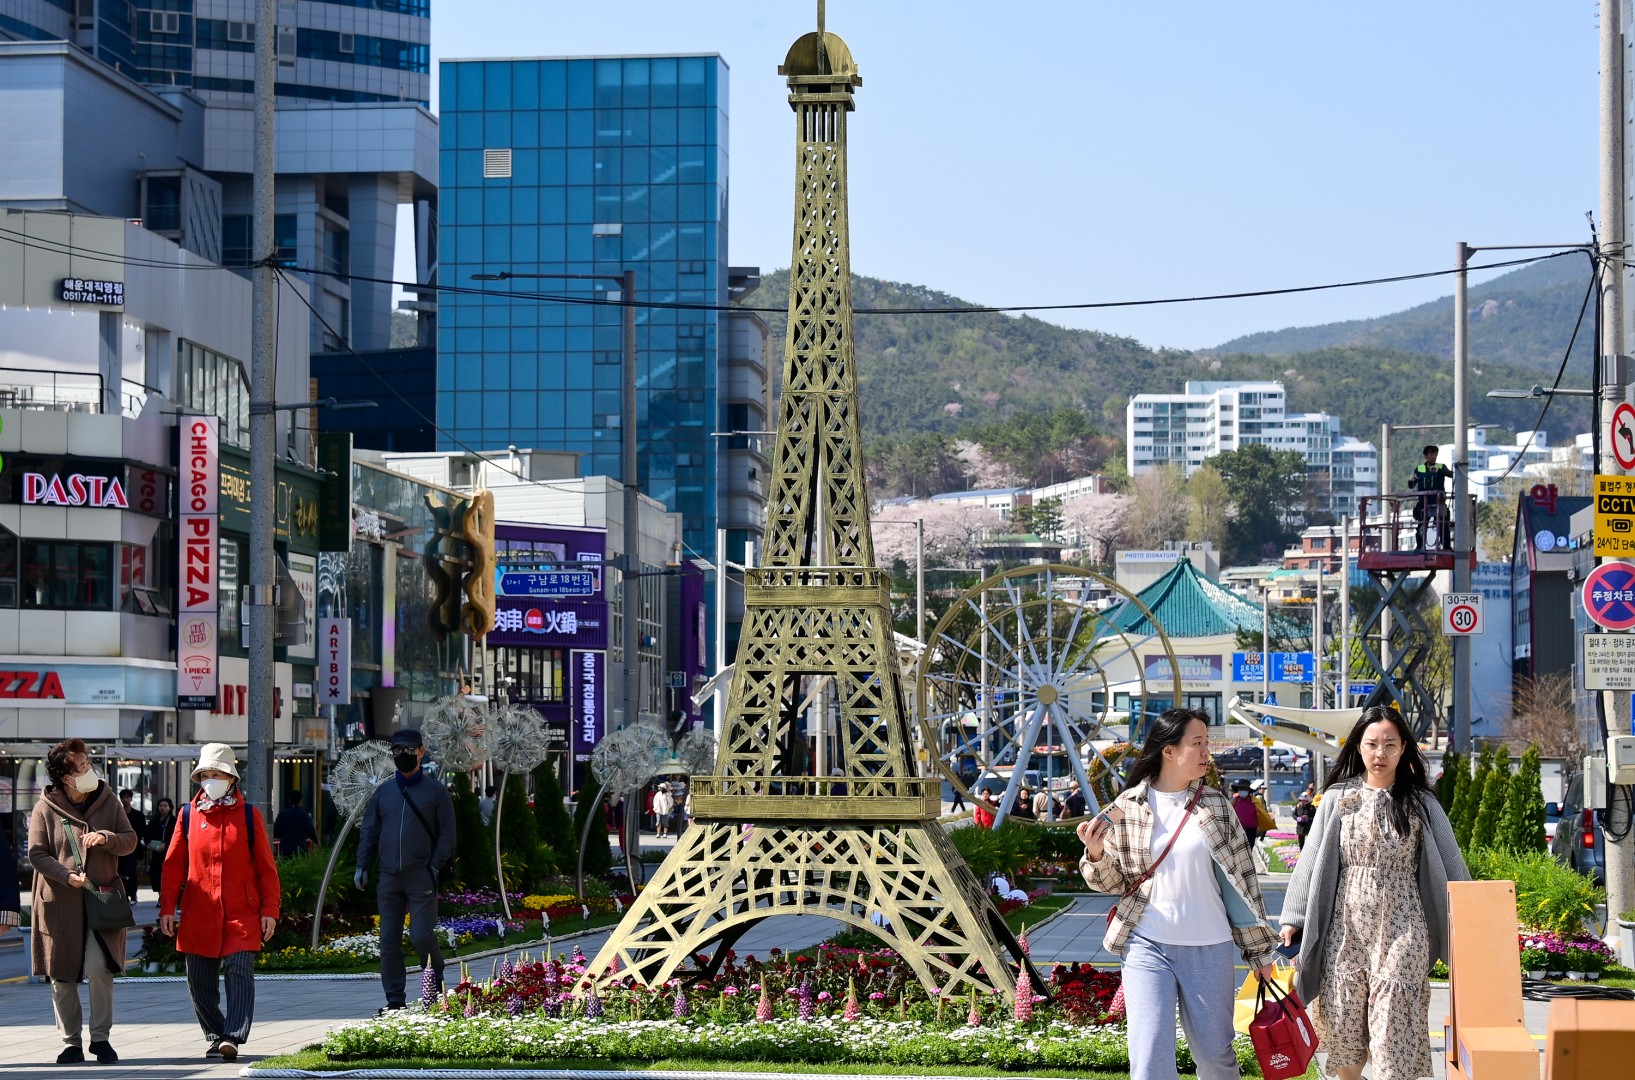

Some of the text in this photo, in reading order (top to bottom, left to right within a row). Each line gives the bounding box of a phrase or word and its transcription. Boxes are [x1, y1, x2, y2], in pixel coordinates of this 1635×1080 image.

[63, 279, 123, 294] 해운대직영점
[63, 291, 123, 304] 051)741-1116
[23, 473, 129, 508] PASTA
[1600, 481, 1635, 493] 불법주·정
[1531, 484, 1558, 515] 약
[186, 422, 210, 607] CHICAGO PIZZA
[1597, 538, 1619, 550] 24시간
[1447, 595, 1479, 605] 30구역
[1592, 590, 1635, 602] 주정차금
[1455, 611, 1472, 626] 30
[328, 625, 340, 698] ARTBOX
[582, 652, 595, 743] 중국정통요리
